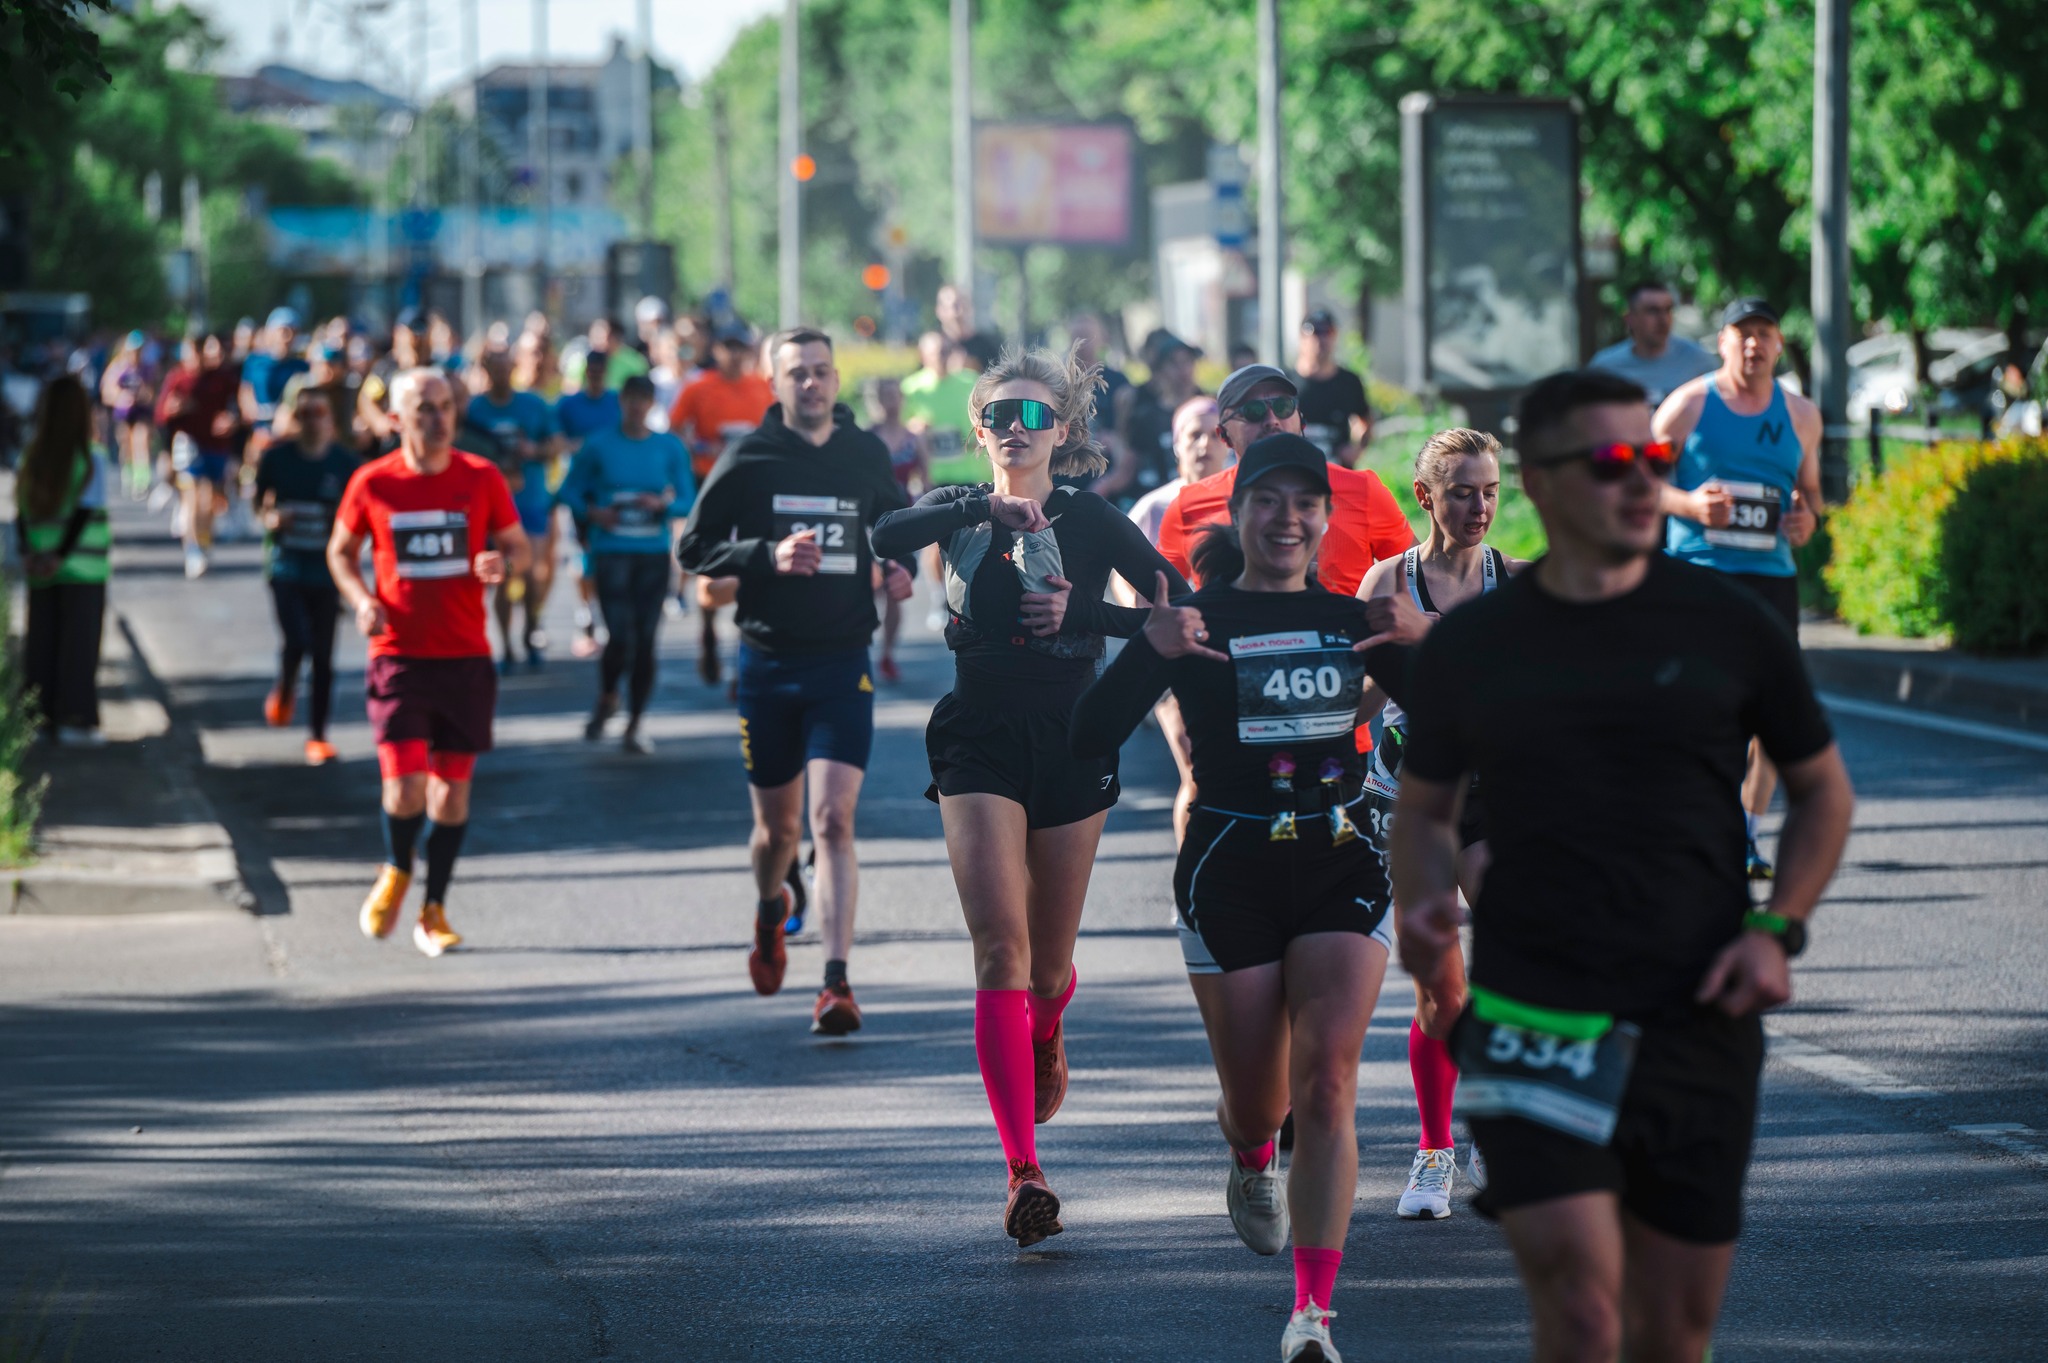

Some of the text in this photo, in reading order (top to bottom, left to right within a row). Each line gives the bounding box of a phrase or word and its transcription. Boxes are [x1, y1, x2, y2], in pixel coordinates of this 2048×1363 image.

[1407, 555, 1414, 564] DO
[1485, 555, 1492, 565] DO
[1406, 564, 1414, 578] JUST
[1486, 564, 1494, 578] JUST
[1238, 638, 1306, 651] НОВА ПОШТА
[1263, 666, 1341, 700] 460
[1487, 1024, 1597, 1081] 534
